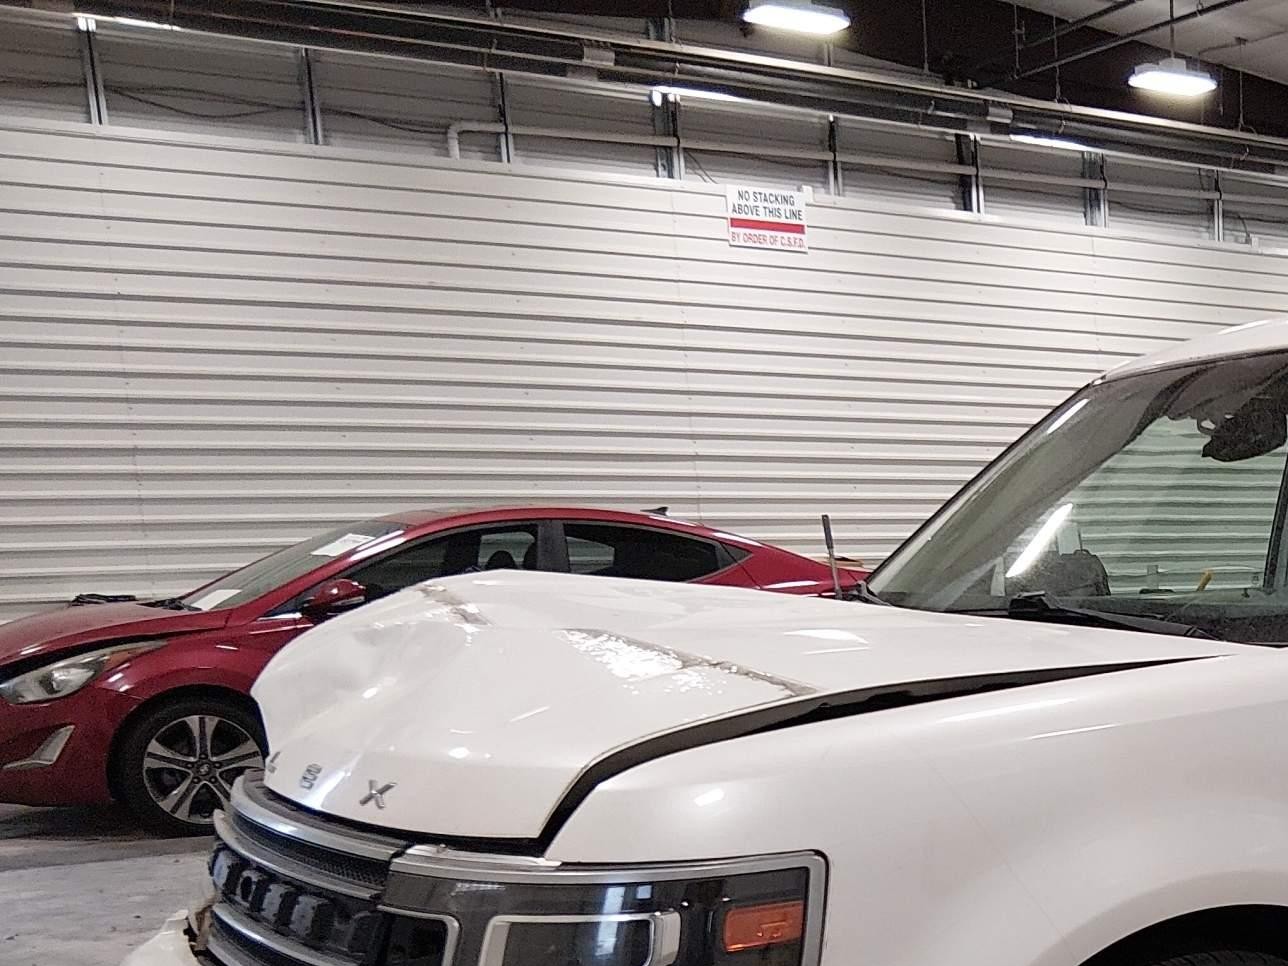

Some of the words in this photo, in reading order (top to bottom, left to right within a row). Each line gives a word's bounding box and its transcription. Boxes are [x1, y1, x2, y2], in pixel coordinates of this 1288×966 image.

[738, 190, 750, 202] NO
[753, 191, 794, 206] STACKING
[732, 204, 760, 216] ABOVE
[763, 206, 783, 219] THIS
[785, 209, 803, 221] LINE
[731, 232, 742, 242] BY
[743, 233, 768, 245] ORDER
[769, 235, 779, 246] OF
